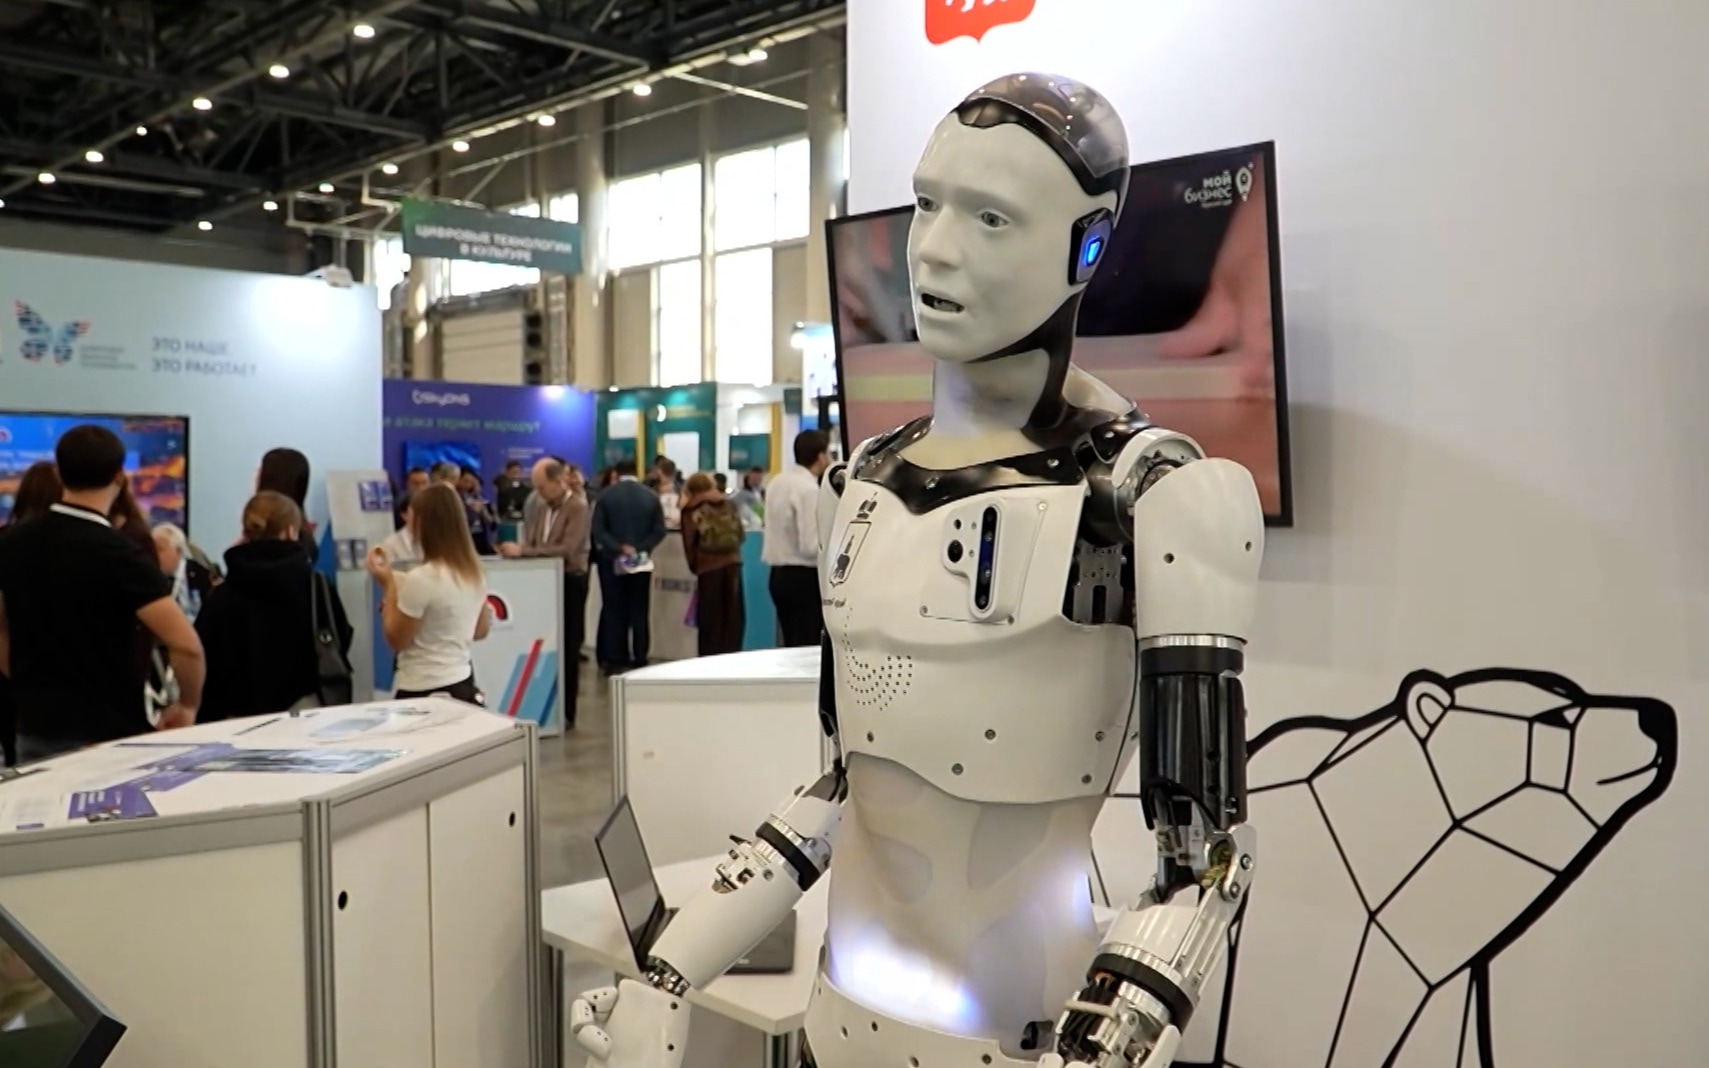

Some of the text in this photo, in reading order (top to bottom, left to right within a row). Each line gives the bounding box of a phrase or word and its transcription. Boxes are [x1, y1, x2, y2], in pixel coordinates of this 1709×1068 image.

[493, 233, 572, 254] ТЕХНОЛОГИИ
[471, 244, 532, 263] КУЛЬТУРЕ
[152, 336, 182, 352] ЭТО
[152, 358, 182, 374] ЭТО
[184, 360, 257, 377] РАБОТАЕТ
